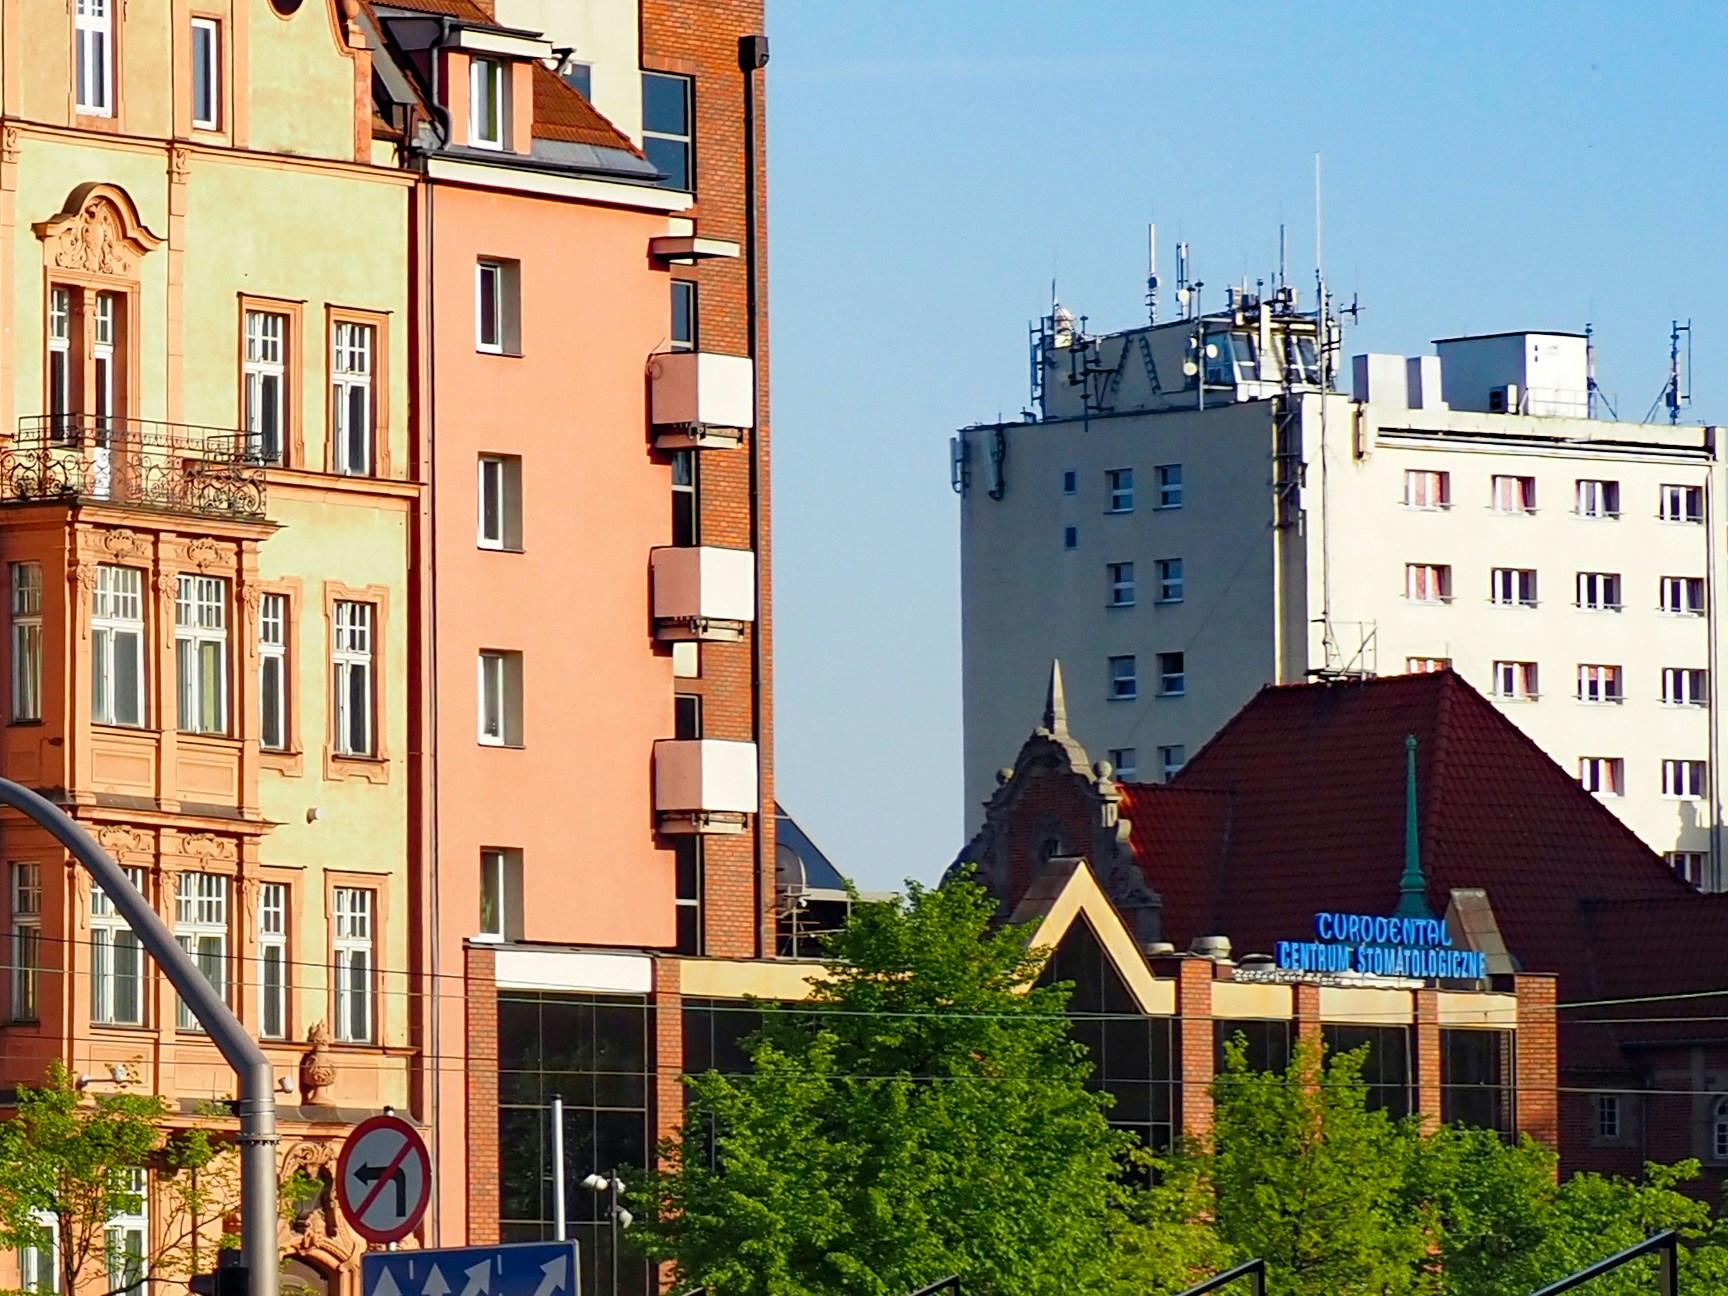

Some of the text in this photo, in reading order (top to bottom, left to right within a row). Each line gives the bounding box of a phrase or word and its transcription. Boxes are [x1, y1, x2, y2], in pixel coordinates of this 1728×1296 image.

[1315, 912, 1453, 947] CURODENTAL
[1279, 941, 1487, 979] CENTRUM STOMATOLOGICZNE
